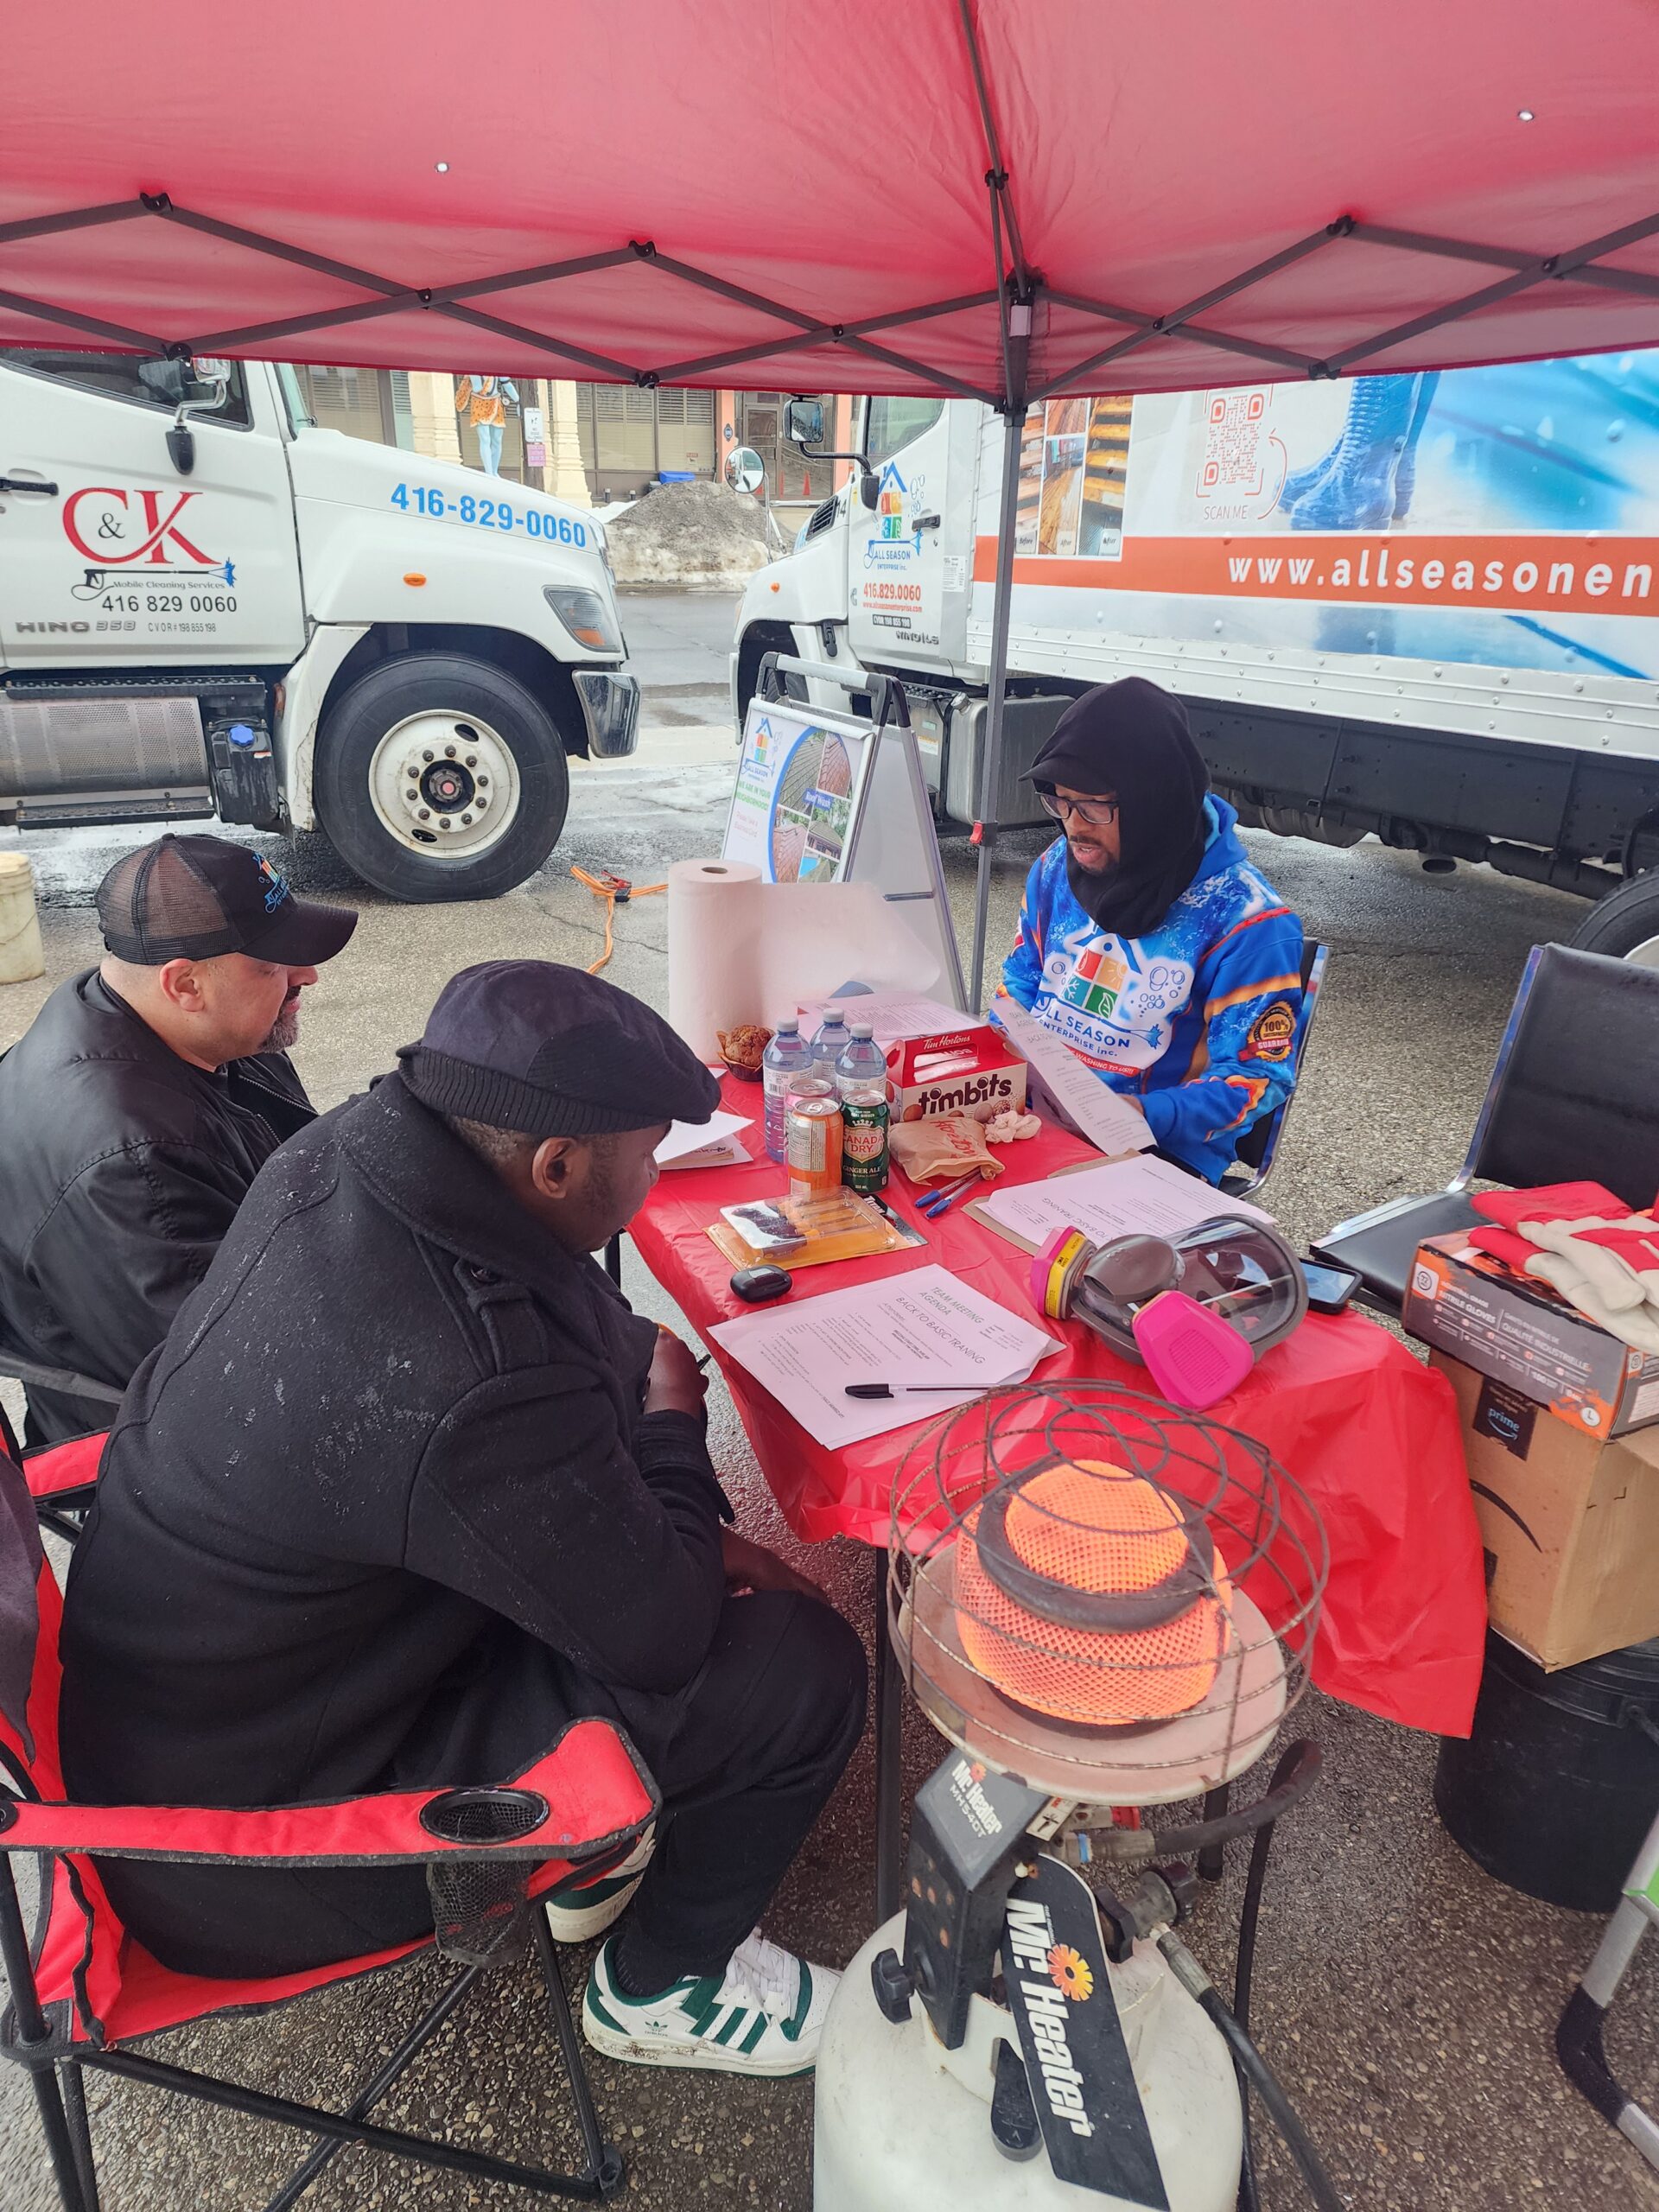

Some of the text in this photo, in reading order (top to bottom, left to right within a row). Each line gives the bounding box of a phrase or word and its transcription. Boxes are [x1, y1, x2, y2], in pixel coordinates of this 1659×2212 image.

[391, 483, 586, 548] 416-829-0060
[1204, 505, 1249, 519] SCAN ME
[874, 550, 911, 561] ALL SEASON
[113, 580, 226, 590] Mobile Cleaning Services
[863, 582, 921, 601] 416.829.0060
[101, 595, 238, 613] 416 829 0060
[16, 621, 90, 632] HINO
[1065, 1015, 1131, 1048] SEASON
[1264, 1020, 1289, 1033] 100%
[923, 1034, 970, 1050] Tim Hortons
[1039, 1018, 1095, 1051] ENTERPRISE
[1096, 1046, 1118, 1057] inc.
[1075, 1052, 1108, 1070] WASHING
[918, 1074, 1012, 1115] timbits
[844, 1134, 885, 1145] CANADA
[843, 1165, 881, 1174] GINGER ALE
[918, 1291, 951, 1316] AGENDA
[931, 1287, 985, 1324] TEAM MEETING
[1465, 1304, 1497, 1324] GLOVES
[895, 1296, 918, 1314] BACK
[917, 1312, 930, 1322] TO
[925, 1320, 952, 1340] BASIC
[951, 1337, 986, 1364] TRANING
[1487, 1408, 1520, 1433] prime
[965, 1782, 1003, 1835] Heater
[1005, 1898, 1093, 2139] Mr. Heater
